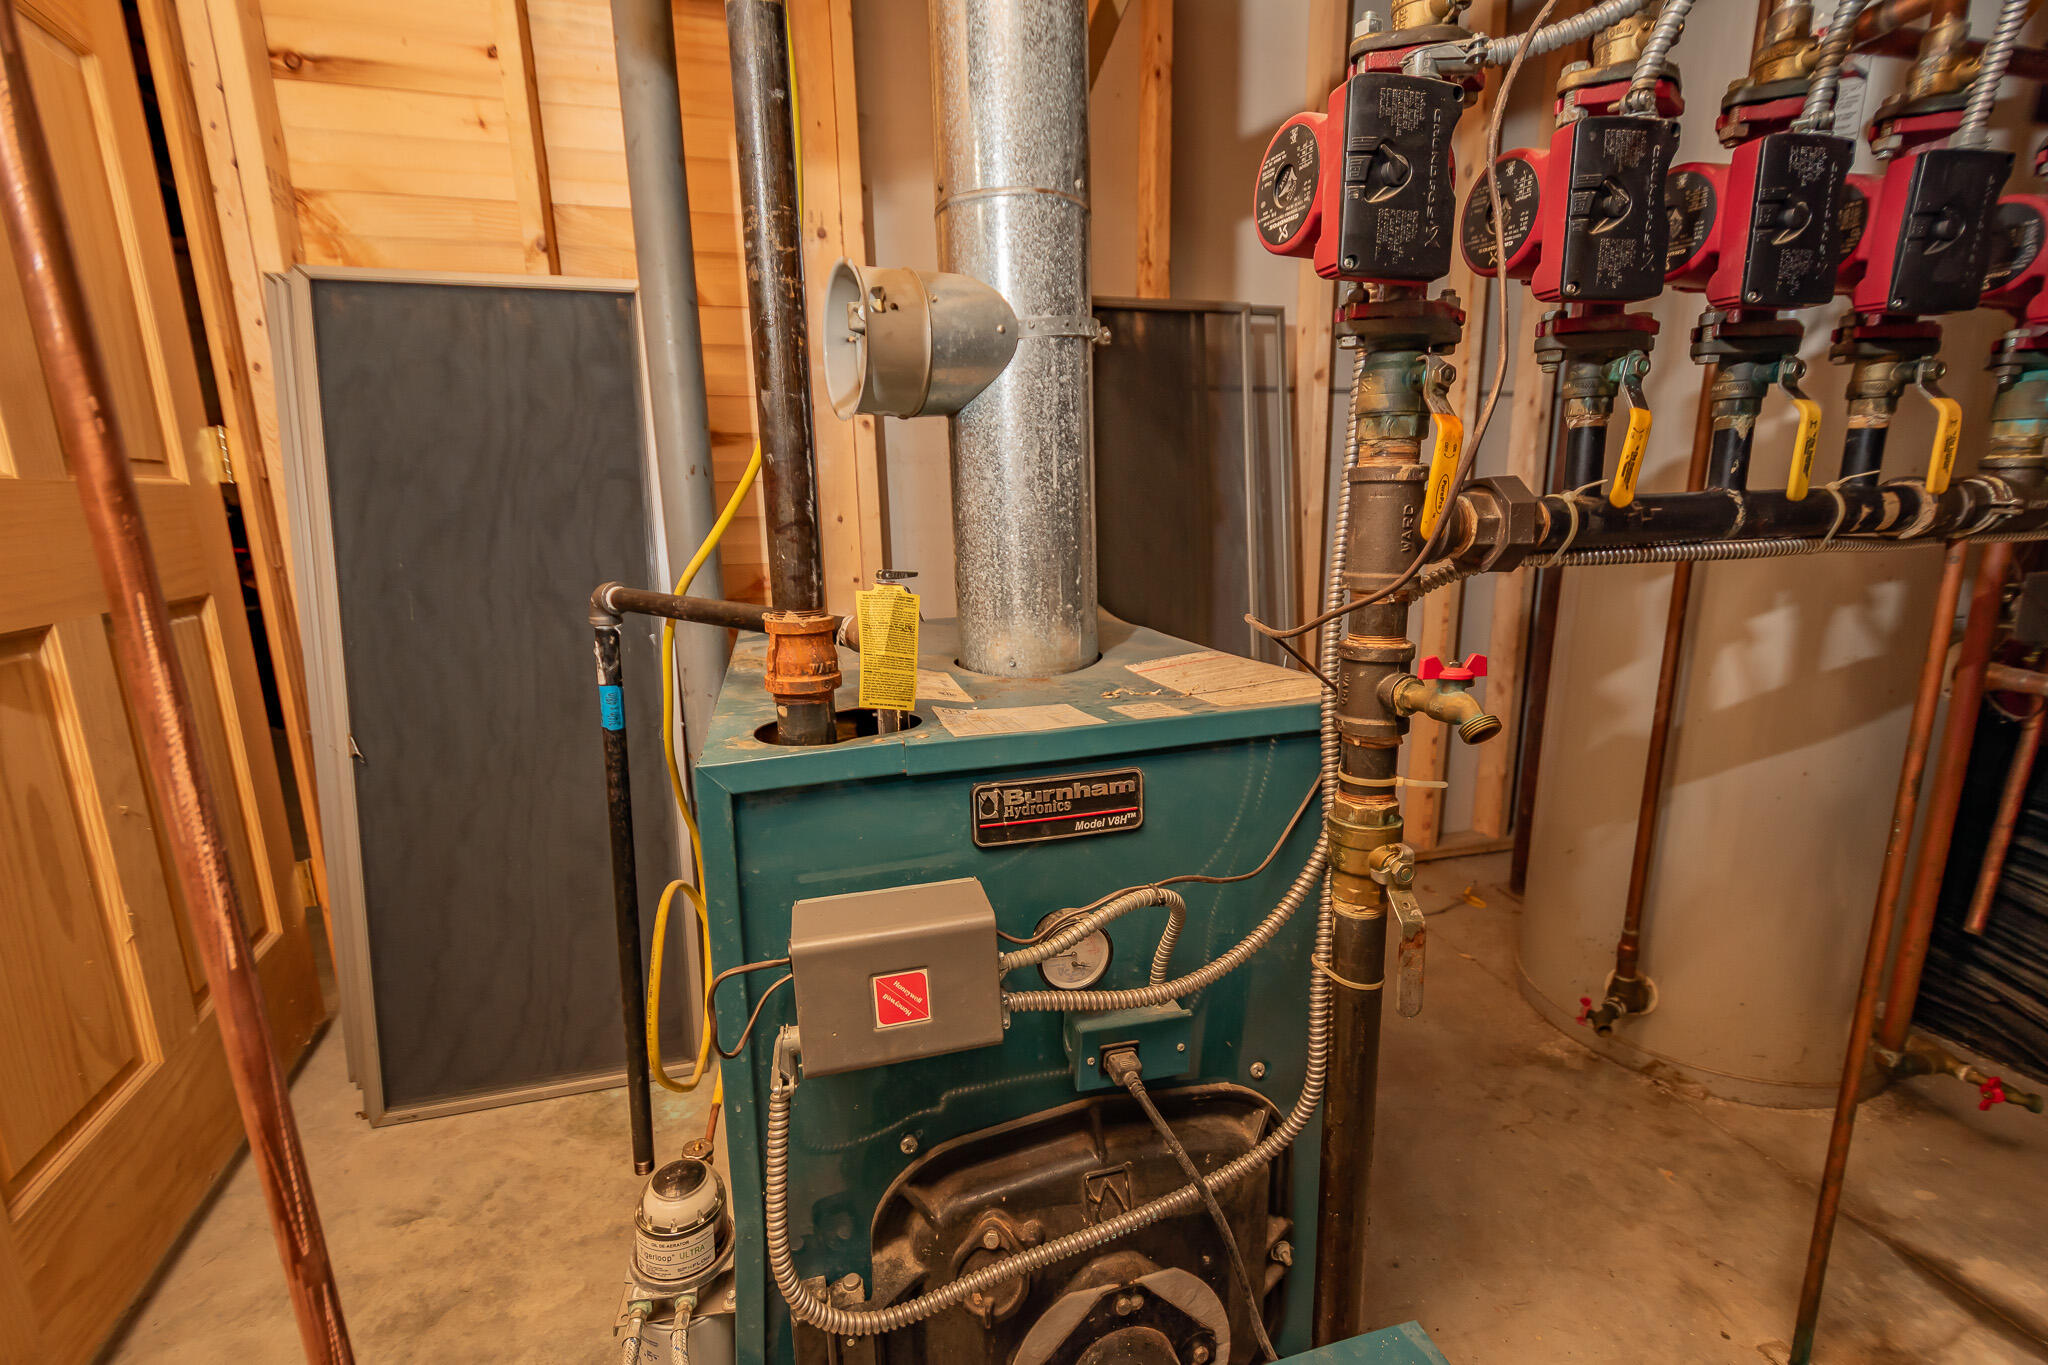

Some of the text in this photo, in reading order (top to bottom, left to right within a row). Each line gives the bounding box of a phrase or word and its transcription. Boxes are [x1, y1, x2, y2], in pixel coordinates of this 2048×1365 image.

[1400, 503, 1415, 554] WARD
[1004, 780, 1136, 805] Burnham
[1004, 800, 1073, 819] Hydronics
[1075, 817, 1106, 831] Model
[893, 980, 923, 1004] Honeywell
[882, 993, 912, 1016] Honeywell
[679, 1244, 706, 1260] ULTRA
